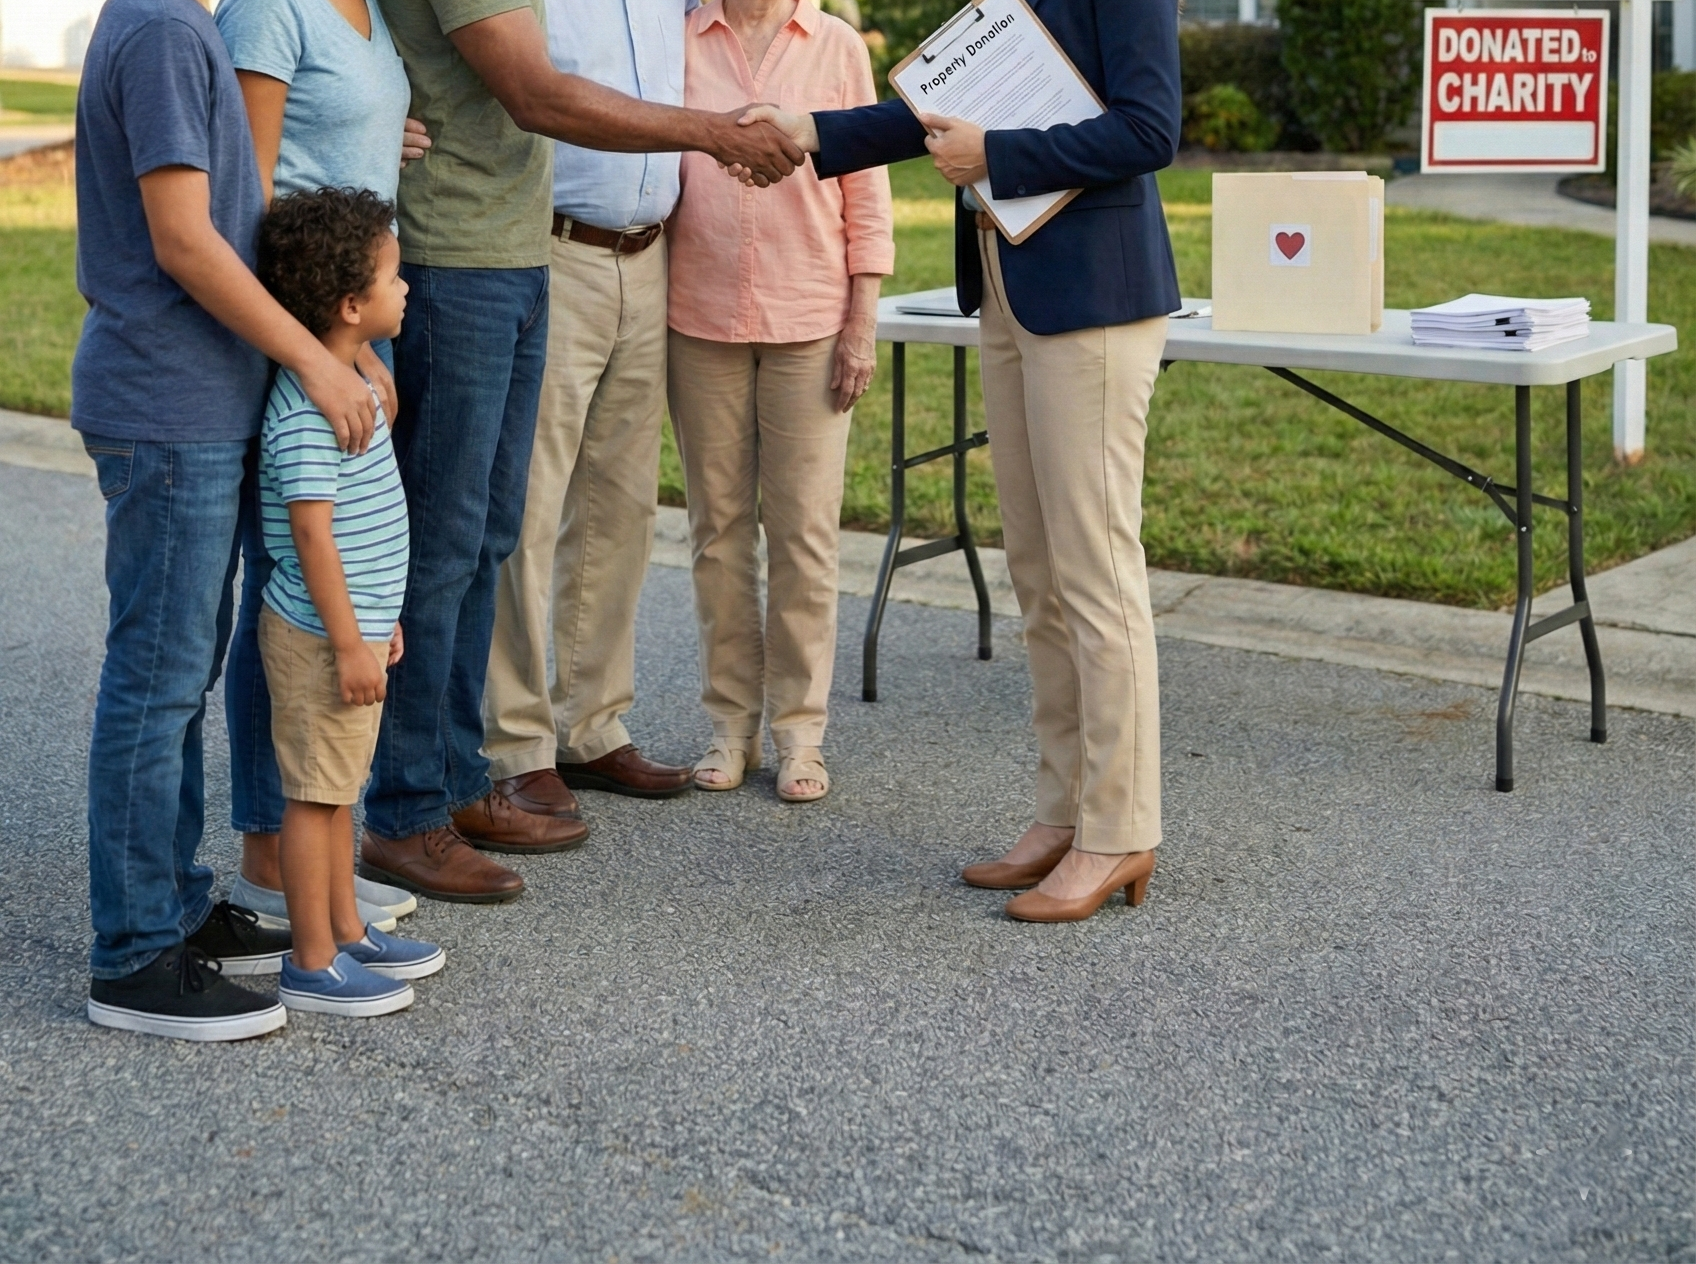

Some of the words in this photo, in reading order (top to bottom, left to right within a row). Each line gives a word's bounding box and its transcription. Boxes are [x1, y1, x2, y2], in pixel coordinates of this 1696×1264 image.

[1438, 27, 1581, 63] DONATED
[1582, 48, 1597, 63] to
[920, 54, 967, 95] Property
[1437, 72, 1593, 113] CHARITY
